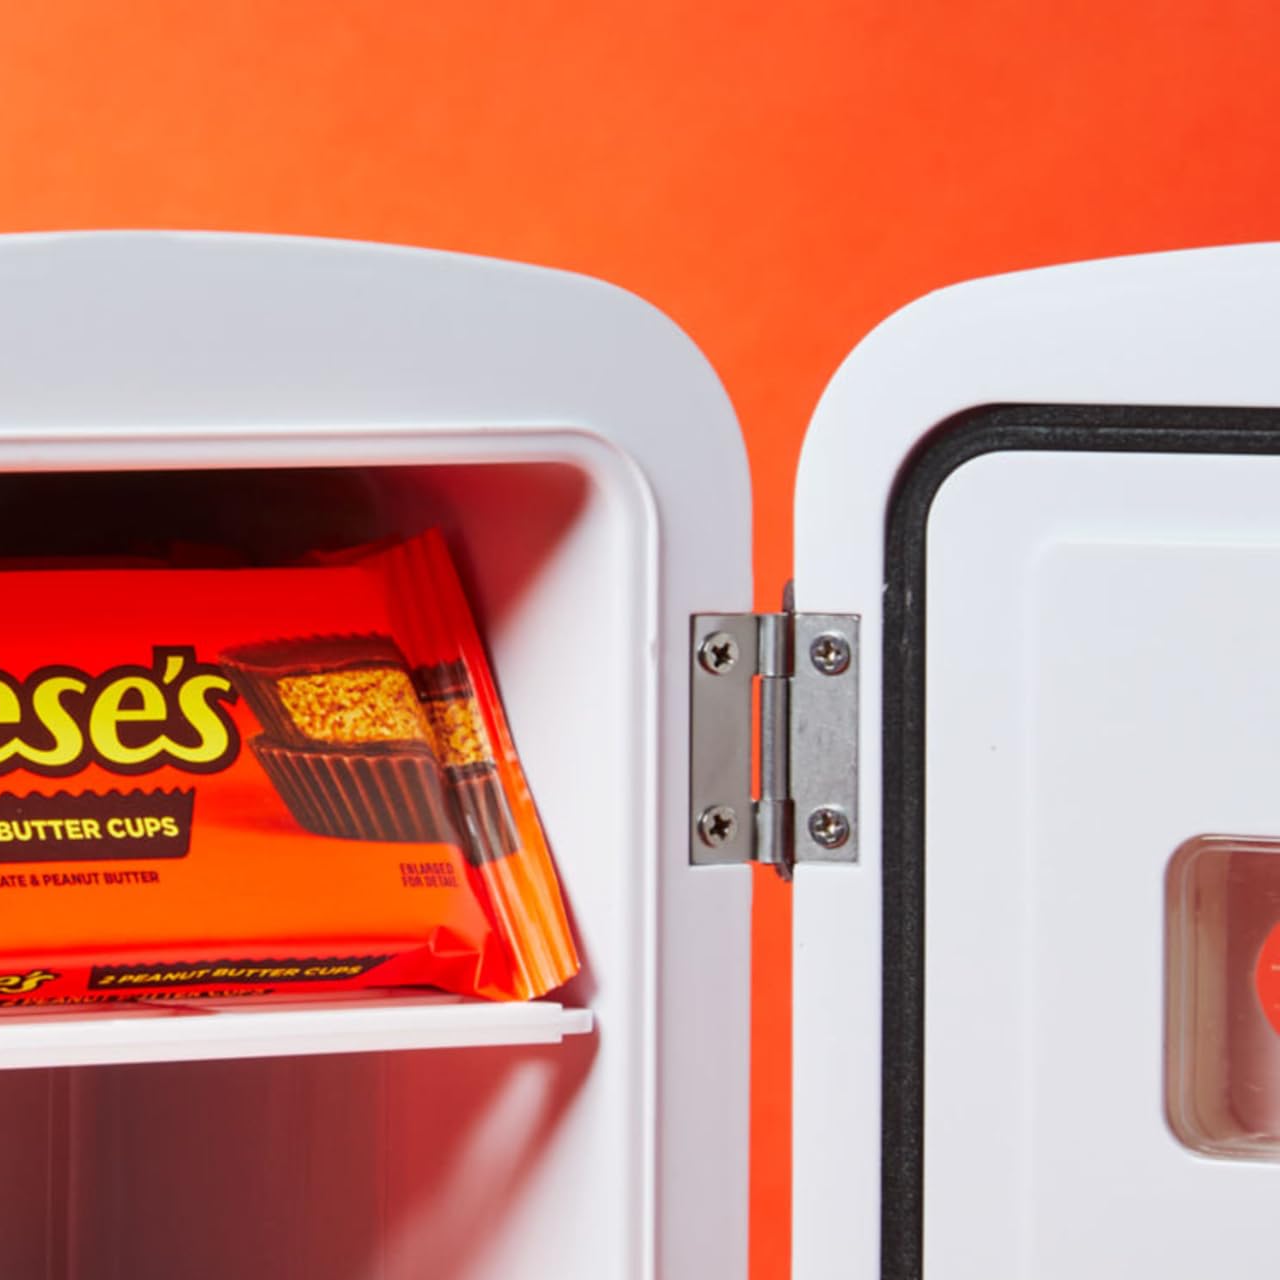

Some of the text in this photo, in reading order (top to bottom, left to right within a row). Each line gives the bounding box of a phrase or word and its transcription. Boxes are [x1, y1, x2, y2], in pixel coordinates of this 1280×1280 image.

[106, 816, 180, 840] CUPS
[30, 874, 40, 888] &
[43, 872, 100, 888] PEANUT
[103, 871, 160, 886] BUTTER
[98, 964, 364, 986] 2 PEANUT BUTTER CUPS
